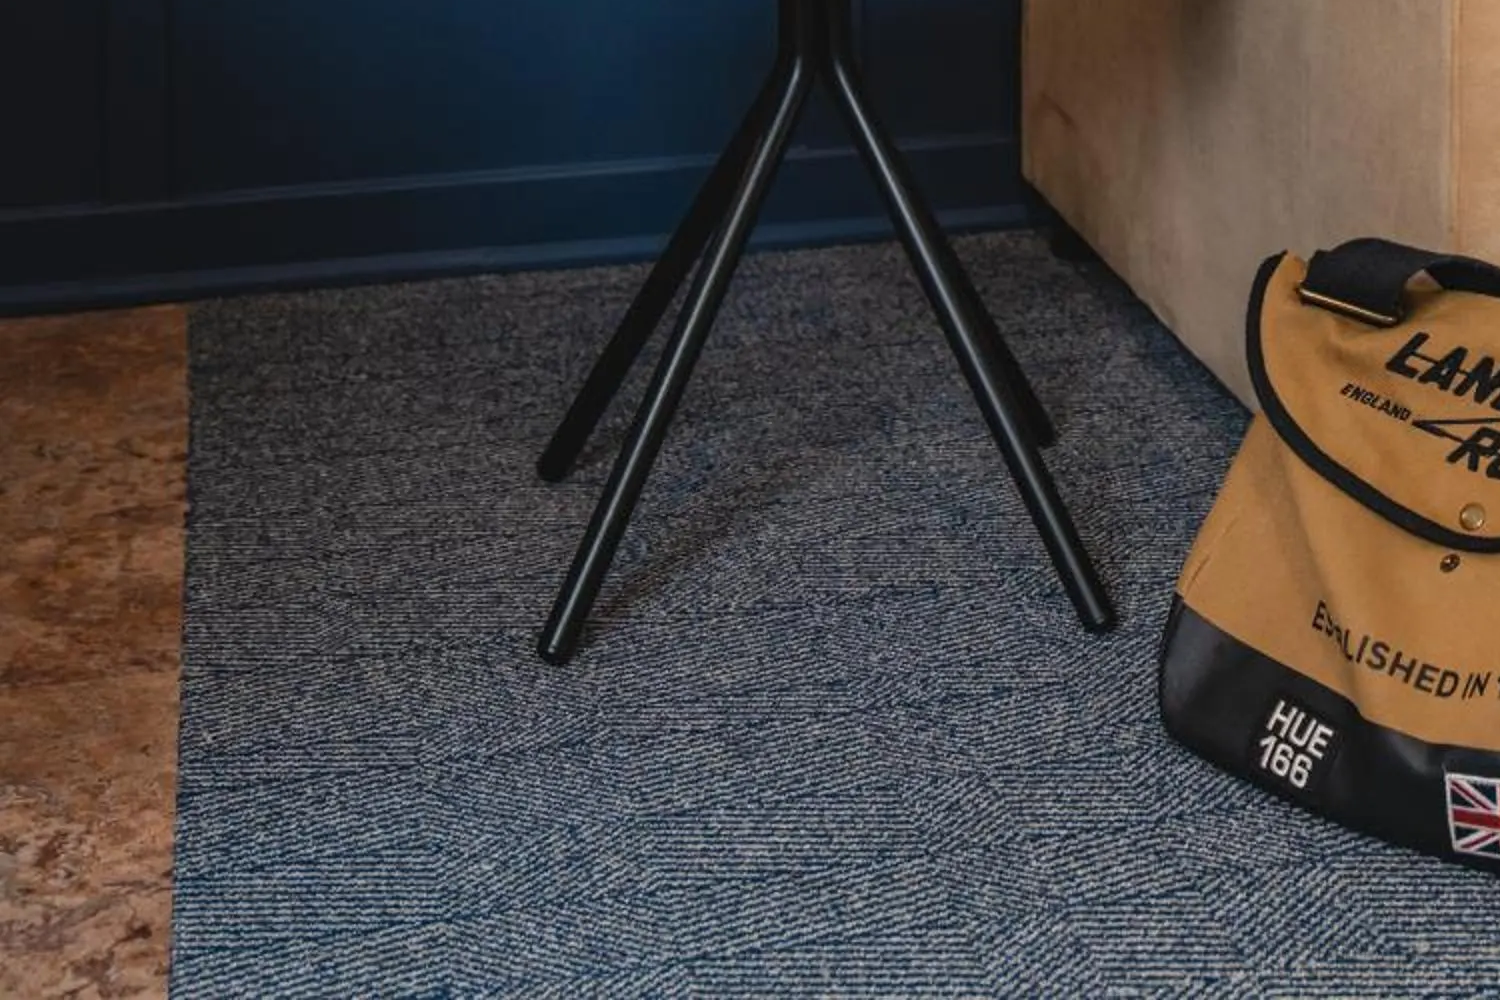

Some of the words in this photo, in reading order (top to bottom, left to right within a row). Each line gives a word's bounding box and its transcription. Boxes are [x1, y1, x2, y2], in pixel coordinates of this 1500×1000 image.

[1340, 383, 1412, 421] ENGLAND
[1461, 671, 1491, 701] IN
[1265, 700, 1334, 761] HUE
[1258, 735, 1314, 789] 166
